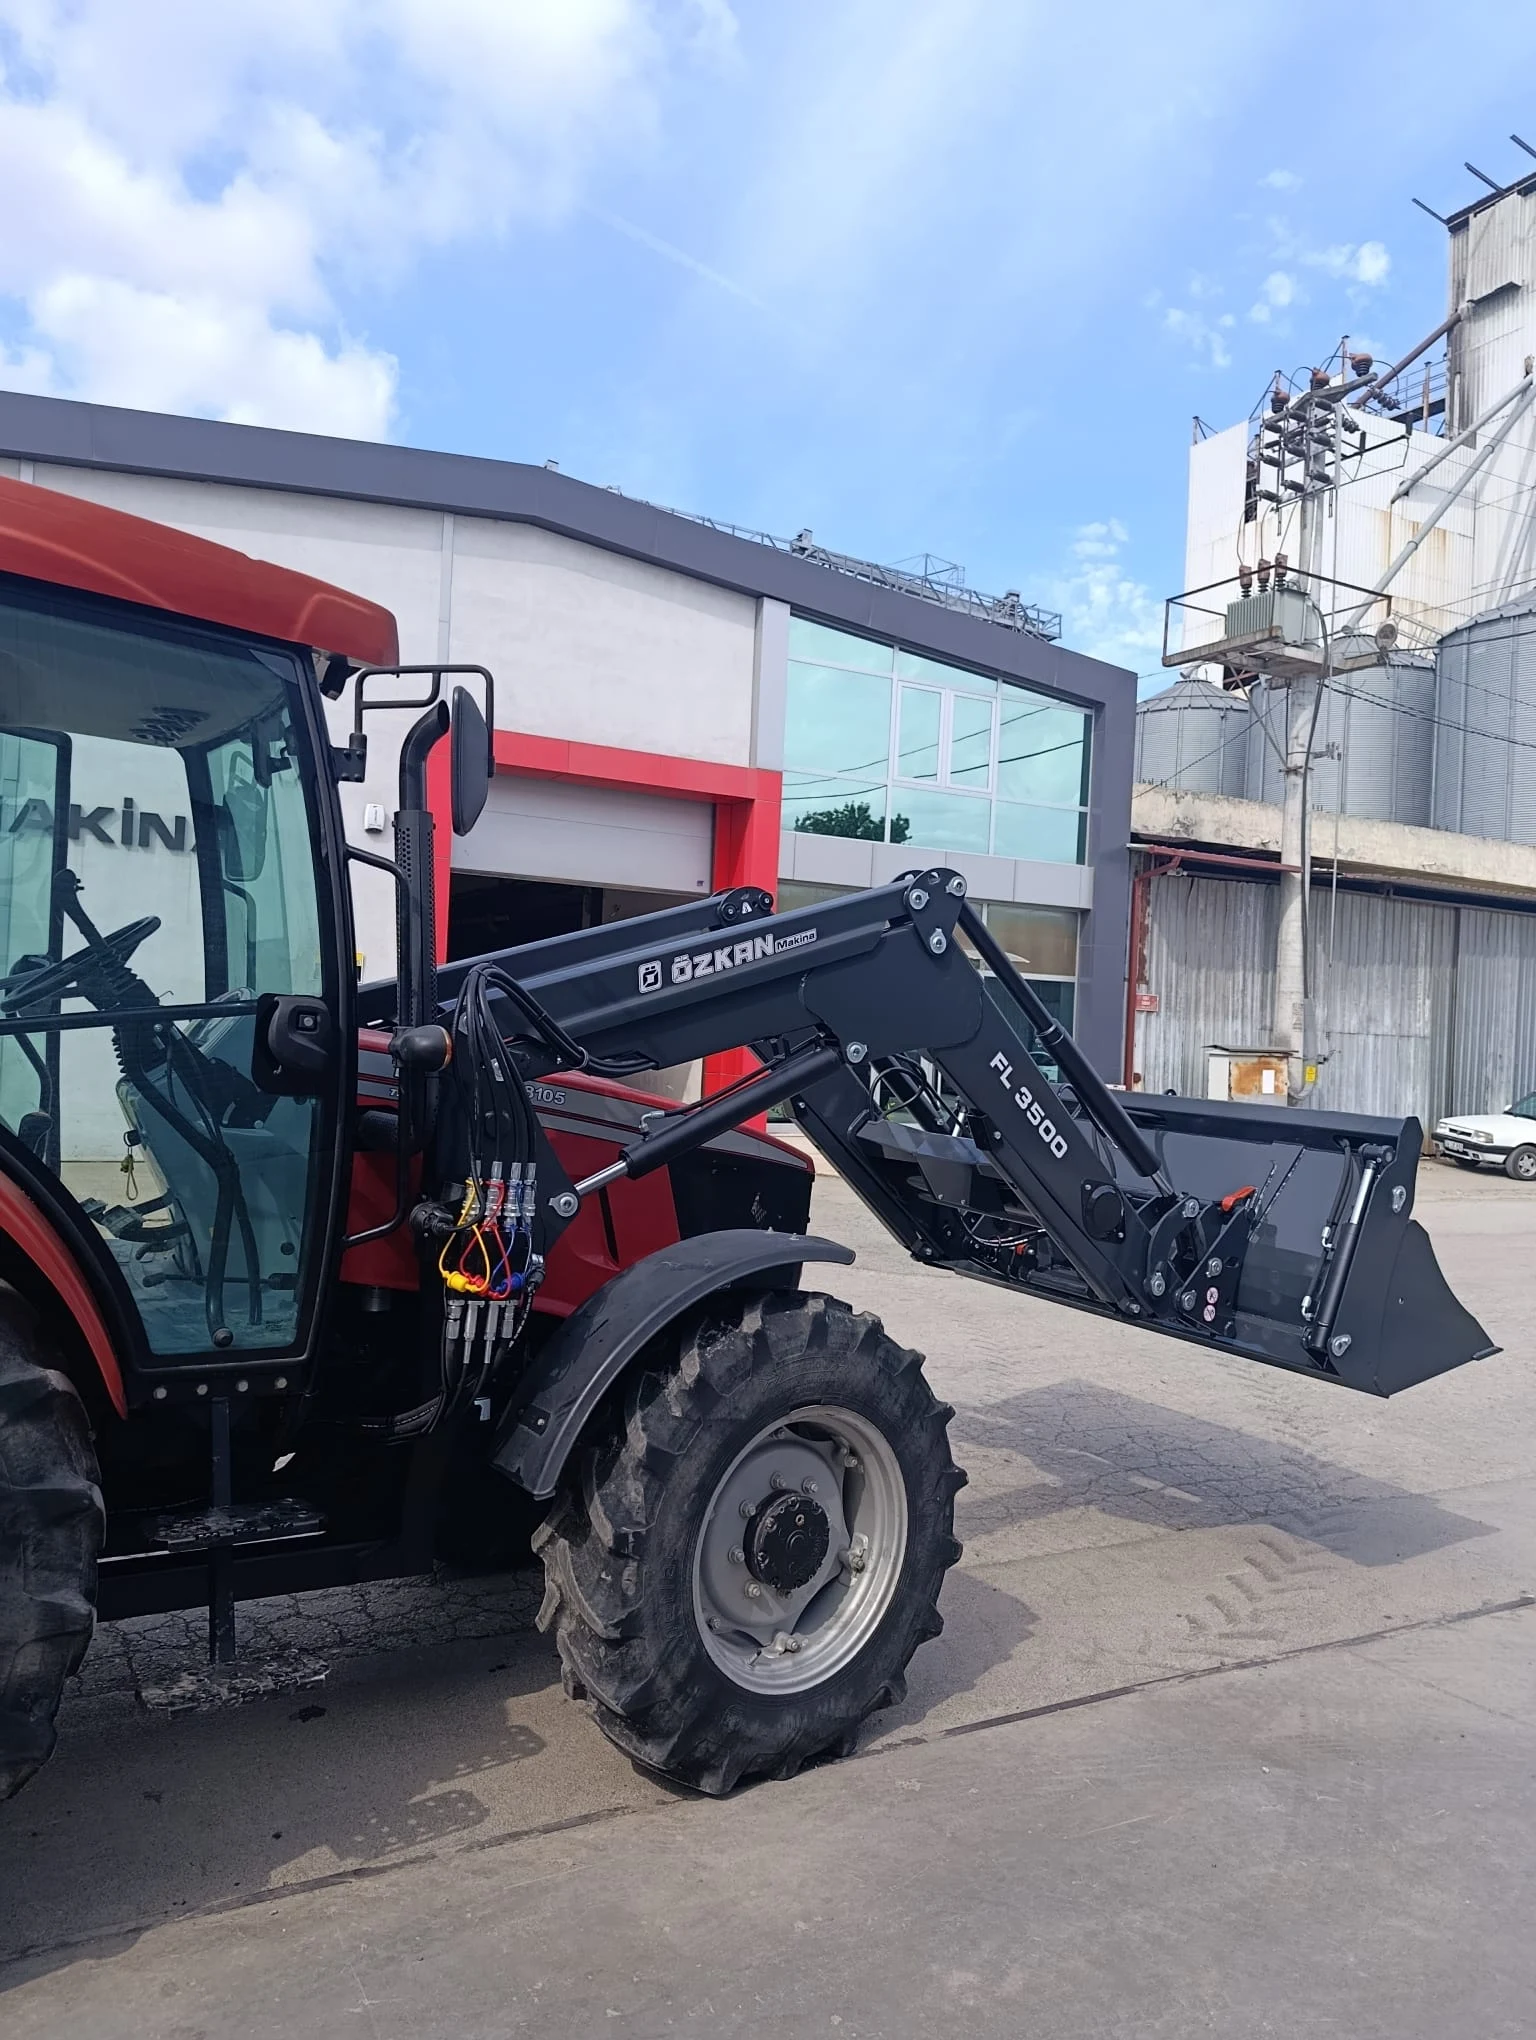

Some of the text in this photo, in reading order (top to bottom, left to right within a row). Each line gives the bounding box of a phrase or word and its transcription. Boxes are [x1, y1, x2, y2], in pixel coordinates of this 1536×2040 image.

[0, 796, 197, 851] AKİN
[672, 932, 816, 984] ÖZKAN Makina
[989, 1051, 1068, 1159] FL 3500
